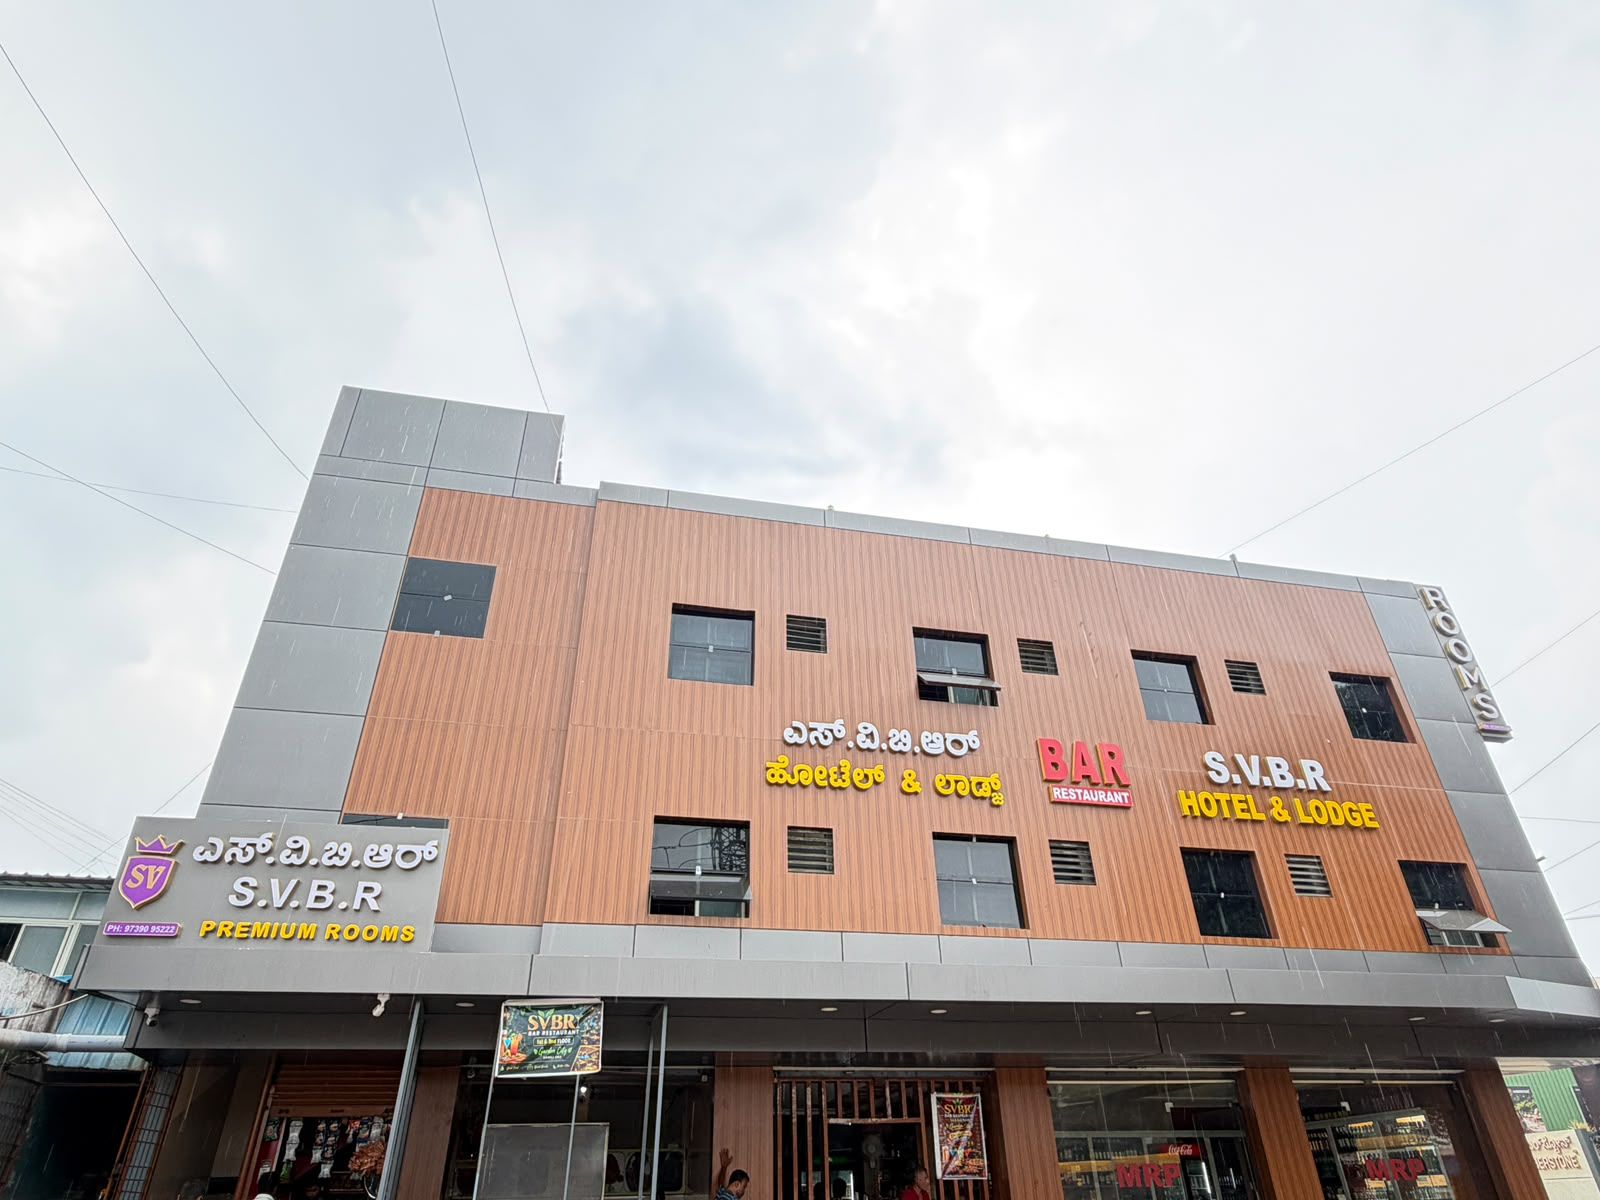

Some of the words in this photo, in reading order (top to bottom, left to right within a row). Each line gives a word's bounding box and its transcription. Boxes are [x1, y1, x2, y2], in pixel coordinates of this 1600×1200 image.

[1420, 586, 1500, 721] ROOMS
[783, 719, 980, 757] ಎಸ್.ವಿ.ಬಿ.ಆರ್
[765, 755, 885, 791] ಹೋಟೆಲ್
[901, 769, 922, 794] &
[1036, 737, 1131, 787] BAR
[1203, 751, 1332, 792] S.V.B.R
[1052, 787, 1130, 803] RESTAURANT
[1178, 790, 1267, 821] HOTEL
[1270, 795, 1291, 823] &
[1294, 798, 1380, 829] LODGE
[192, 832, 439, 870] ಎಸ್.ವಿ.ಬಿ.ಆರ್
[126, 864, 166, 889] SV
[228, 876, 383, 912] S.V.B.R
[107, 924, 123, 932] PH:
[124, 924, 149, 933] 97390
[150, 925, 176, 933] 95222
[199, 920, 317, 940] PREMIUM
[325, 923, 416, 942] ROOMS
[1115, 1163, 1182, 1188] MRP
[1365, 1158, 1426, 1181] MRP
